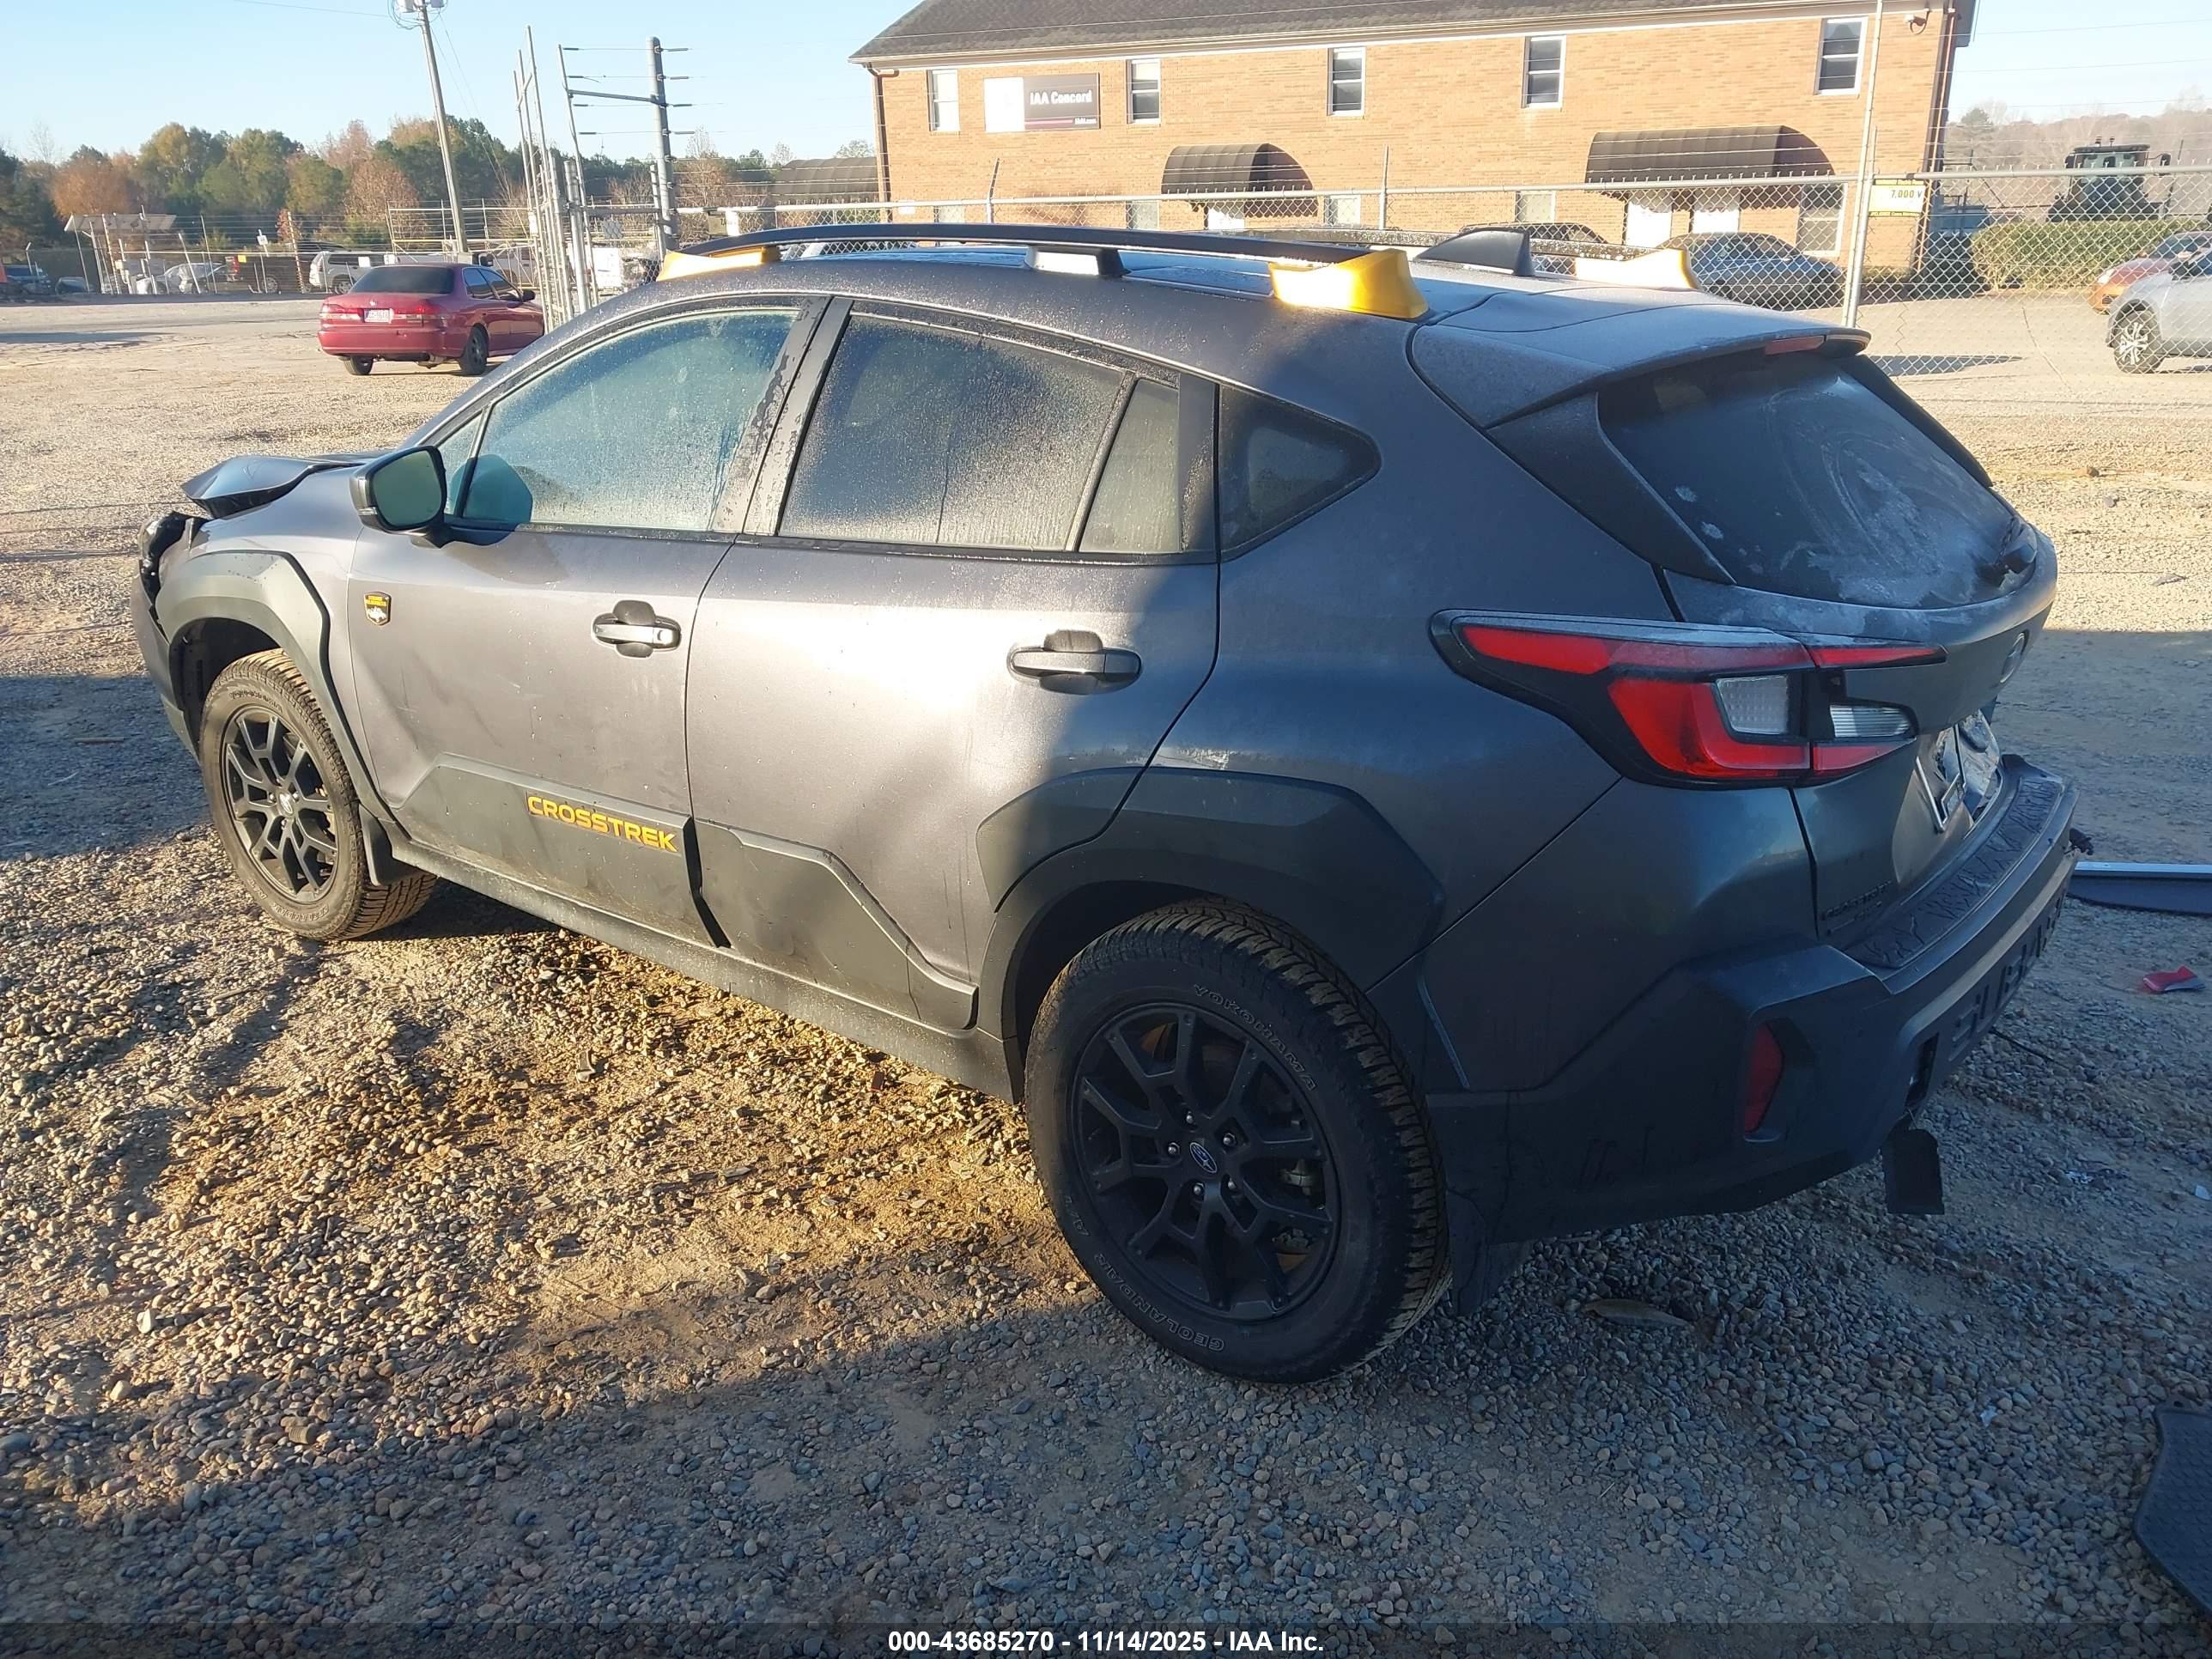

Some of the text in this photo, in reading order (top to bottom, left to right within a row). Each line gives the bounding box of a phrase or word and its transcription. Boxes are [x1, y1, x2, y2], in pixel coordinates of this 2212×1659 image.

[1031, 90, 1092, 105] IAA Concord
[527, 795, 678, 853] CROSSTREK
[1193, 981, 1319, 1091] YOKOHAMA
[1094, 1252, 1225, 1353] GEOLANDAR
